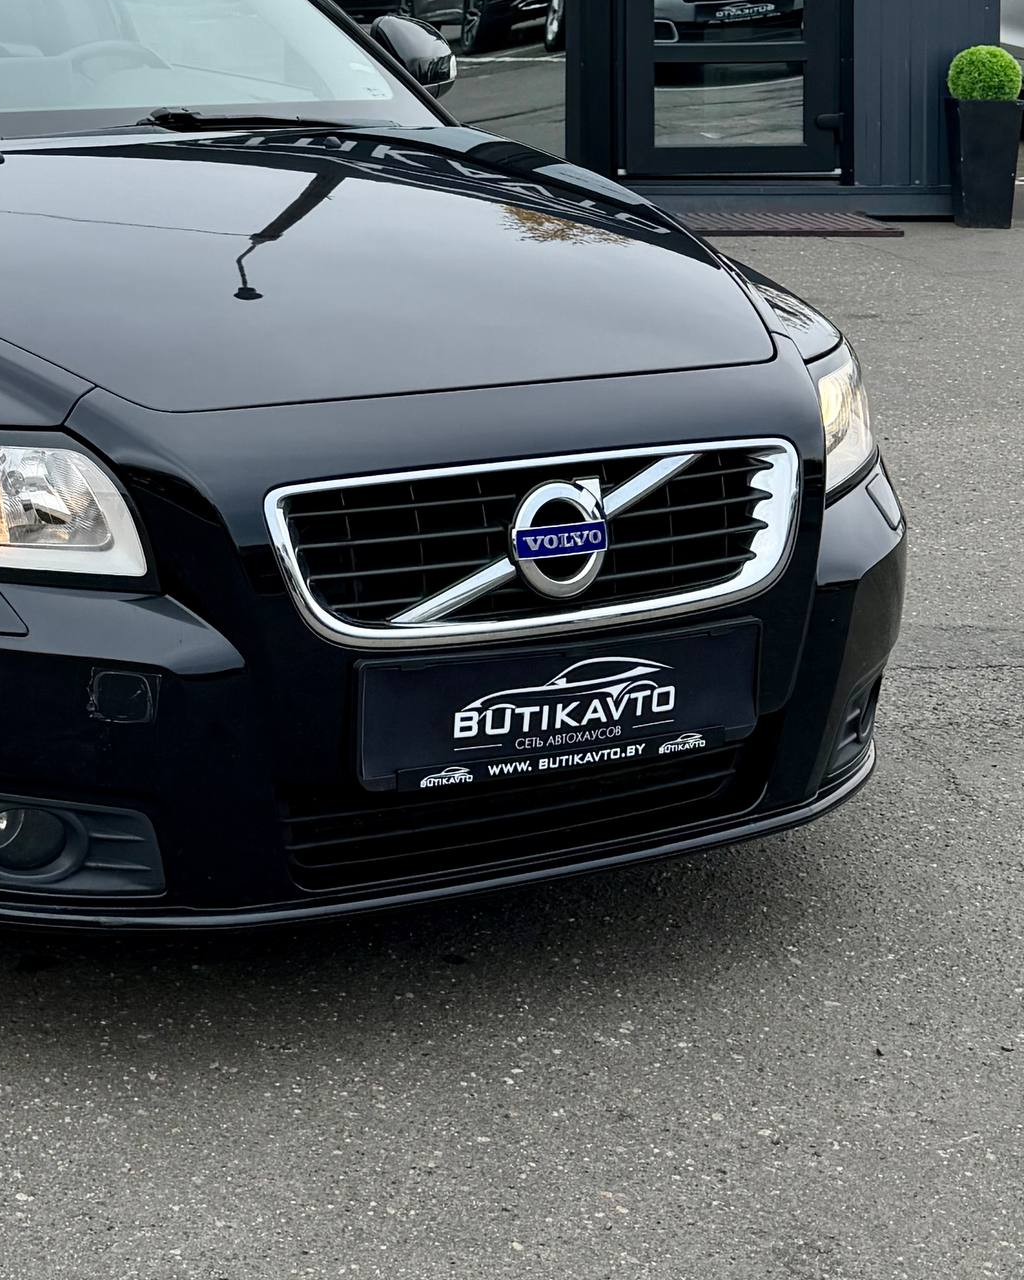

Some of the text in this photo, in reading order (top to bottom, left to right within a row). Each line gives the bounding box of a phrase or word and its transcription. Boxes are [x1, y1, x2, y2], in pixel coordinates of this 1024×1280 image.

[522, 529, 602, 551] VOLVO
[453, 685, 676, 738] BUTIKAVTO
[515, 725, 622, 750] СЕТЬ АВТОХАУСОВ
[658, 739, 706, 754] BUTIKAVTO
[538, 743, 646, 770] BUTIKAVTO.BY
